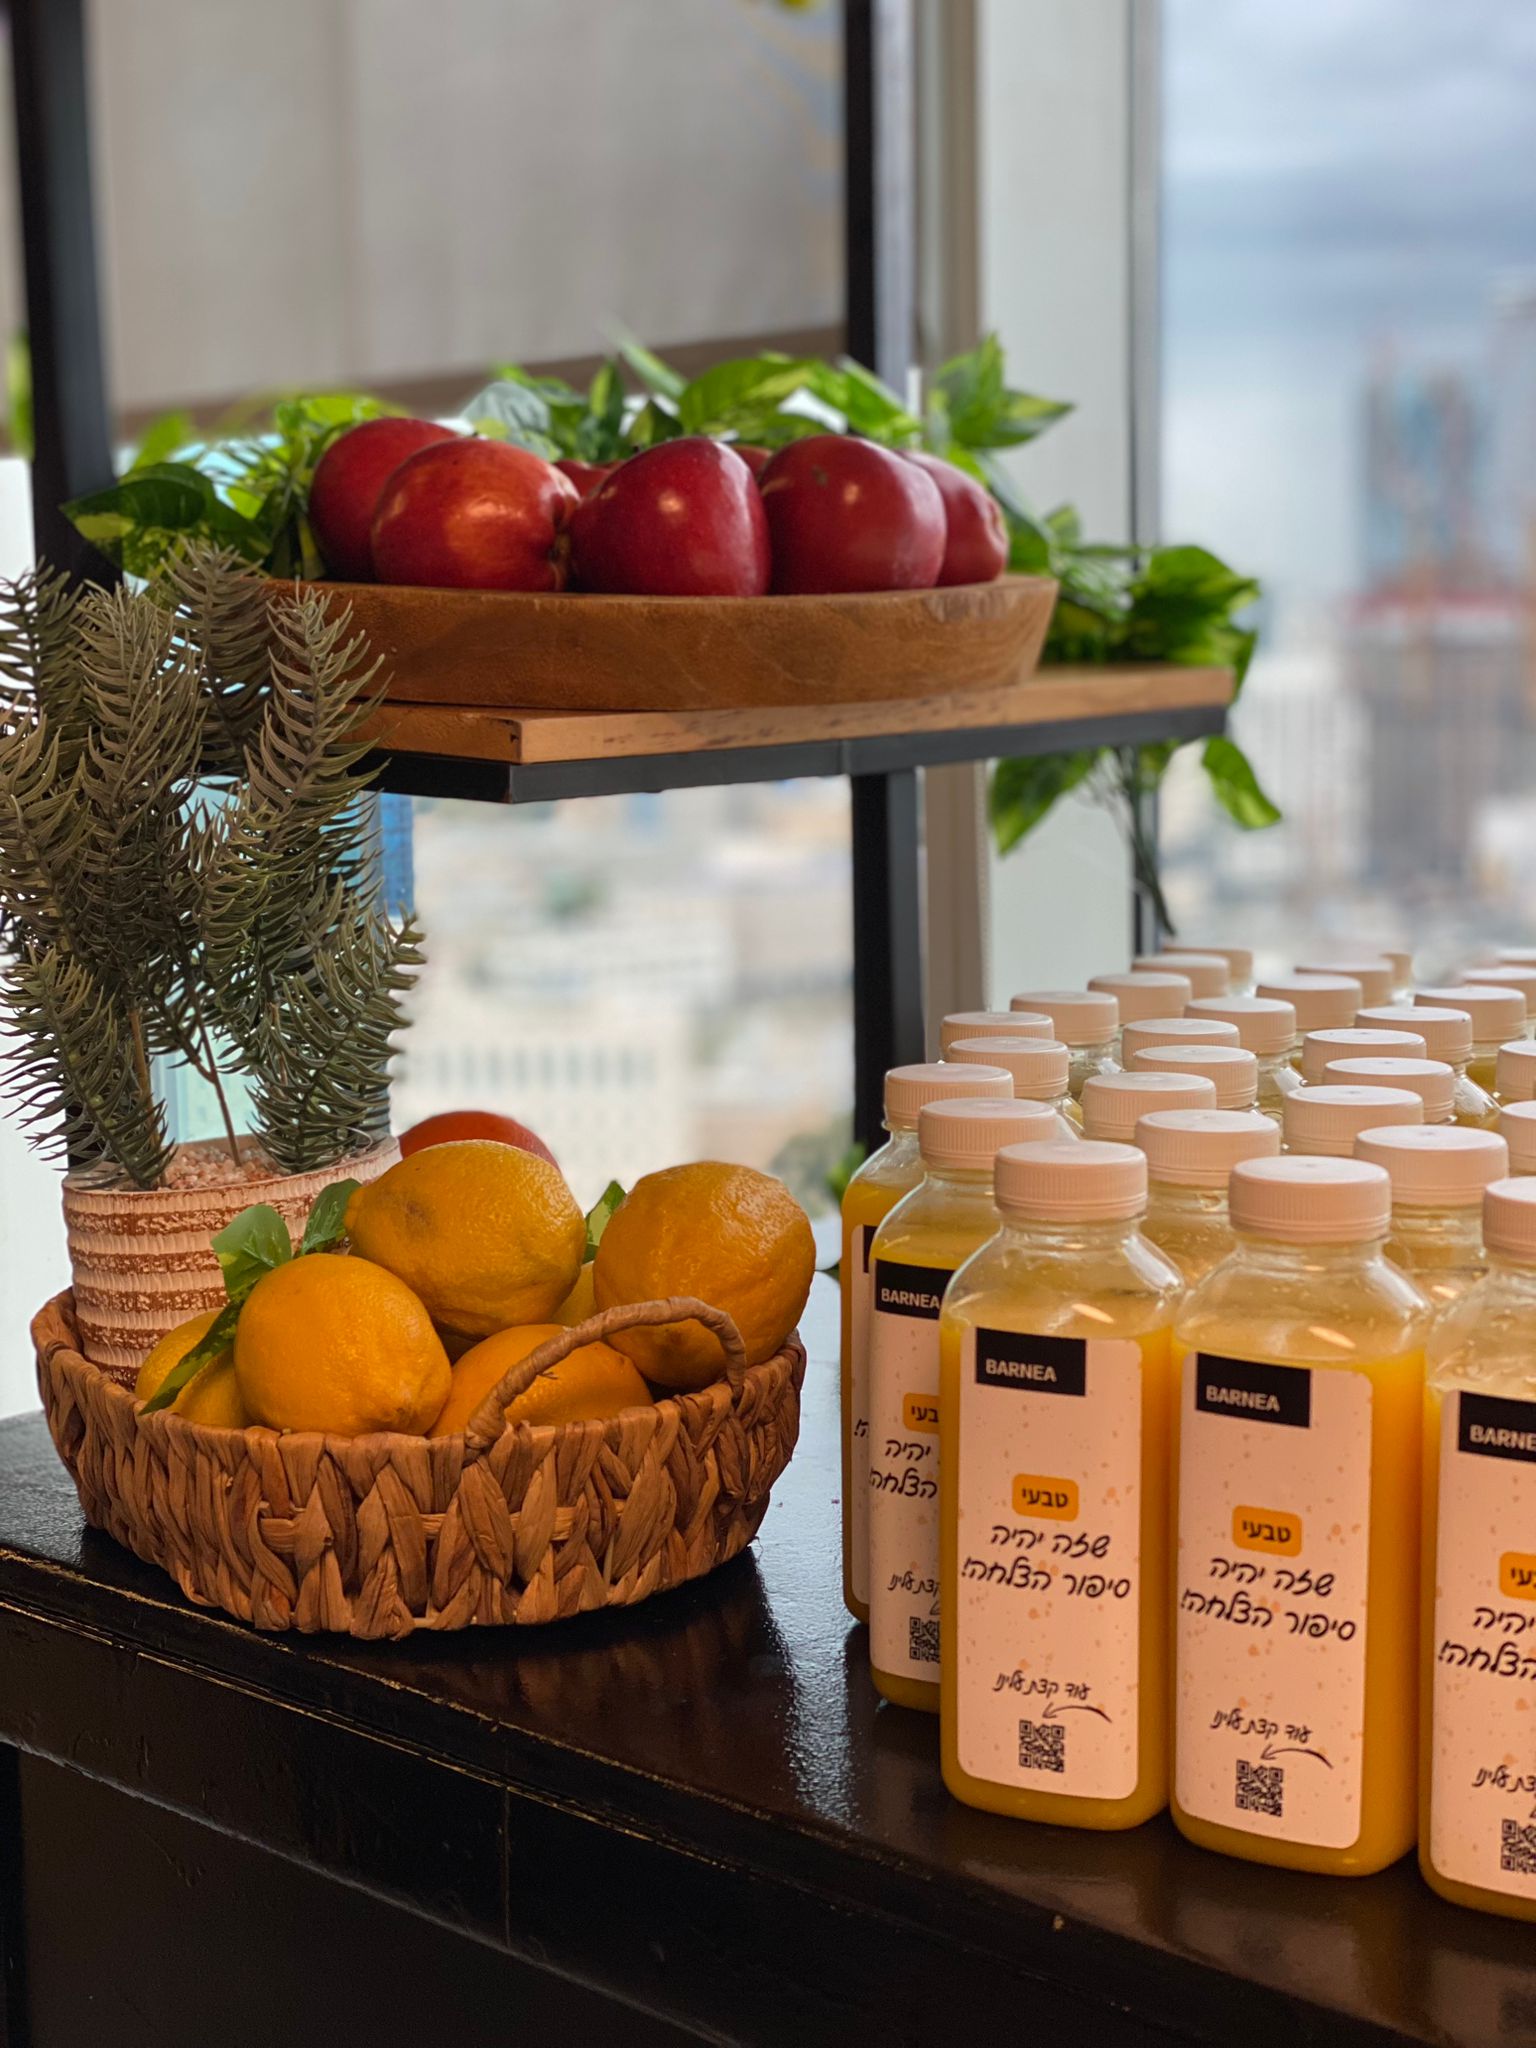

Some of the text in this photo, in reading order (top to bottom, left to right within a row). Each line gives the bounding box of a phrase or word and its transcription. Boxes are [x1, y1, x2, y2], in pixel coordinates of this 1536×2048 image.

[881, 1287, 940, 1310] BARNEA
[985, 1358, 1057, 1383] BARNEA
[1205, 1385, 1280, 1412] BARNEA
[911, 1405, 939, 1423] בעי
[885, 1439, 931, 1461] יהיה
[1469, 1424, 1536, 1452] BARNE
[1022, 1487, 1069, 1508] טבעי
[990, 1525, 1111, 1559] שזה יהיה
[1242, 1520, 1292, 1543] טבעי
[961, 1556, 1131, 1599] סיפור הצלחה!
[1209, 1557, 1336, 1597] שזה יהיה
[1181, 1588, 1356, 1641] סיפור הצלחה!
[1472, 1607, 1536, 1634] יהיה
[1022, 1678, 1059, 1699] קצת
[1240, 1718, 1278, 1740] קצת
[1506, 1775, 1536, 1793] צת
